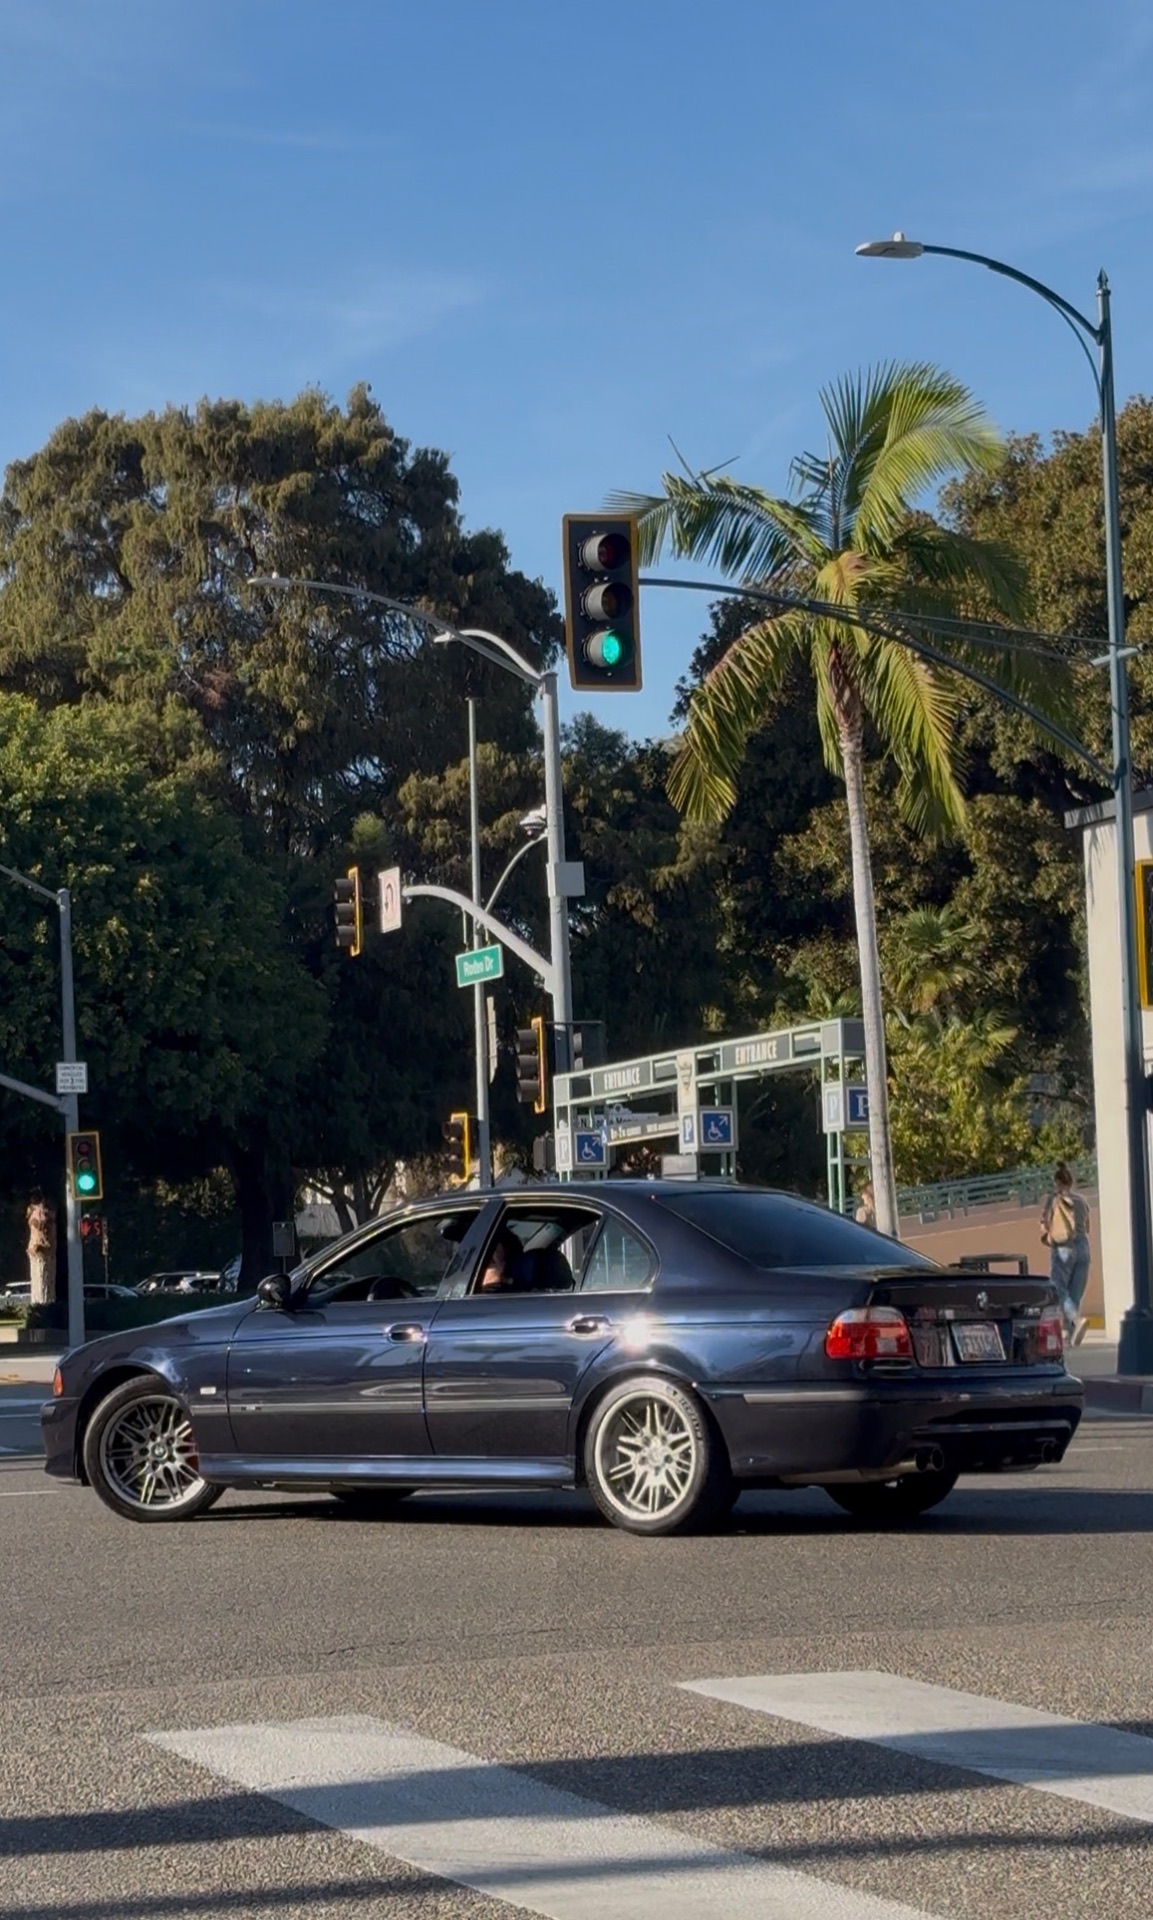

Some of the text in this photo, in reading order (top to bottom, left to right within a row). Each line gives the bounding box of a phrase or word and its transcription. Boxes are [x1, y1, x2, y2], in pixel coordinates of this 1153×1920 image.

[484, 956, 494, 972] Dr
[735, 1040, 777, 1065] ENTRANCE
[604, 1066, 640, 1091] ENTRANCE
[684, 1117, 693, 1141] P
